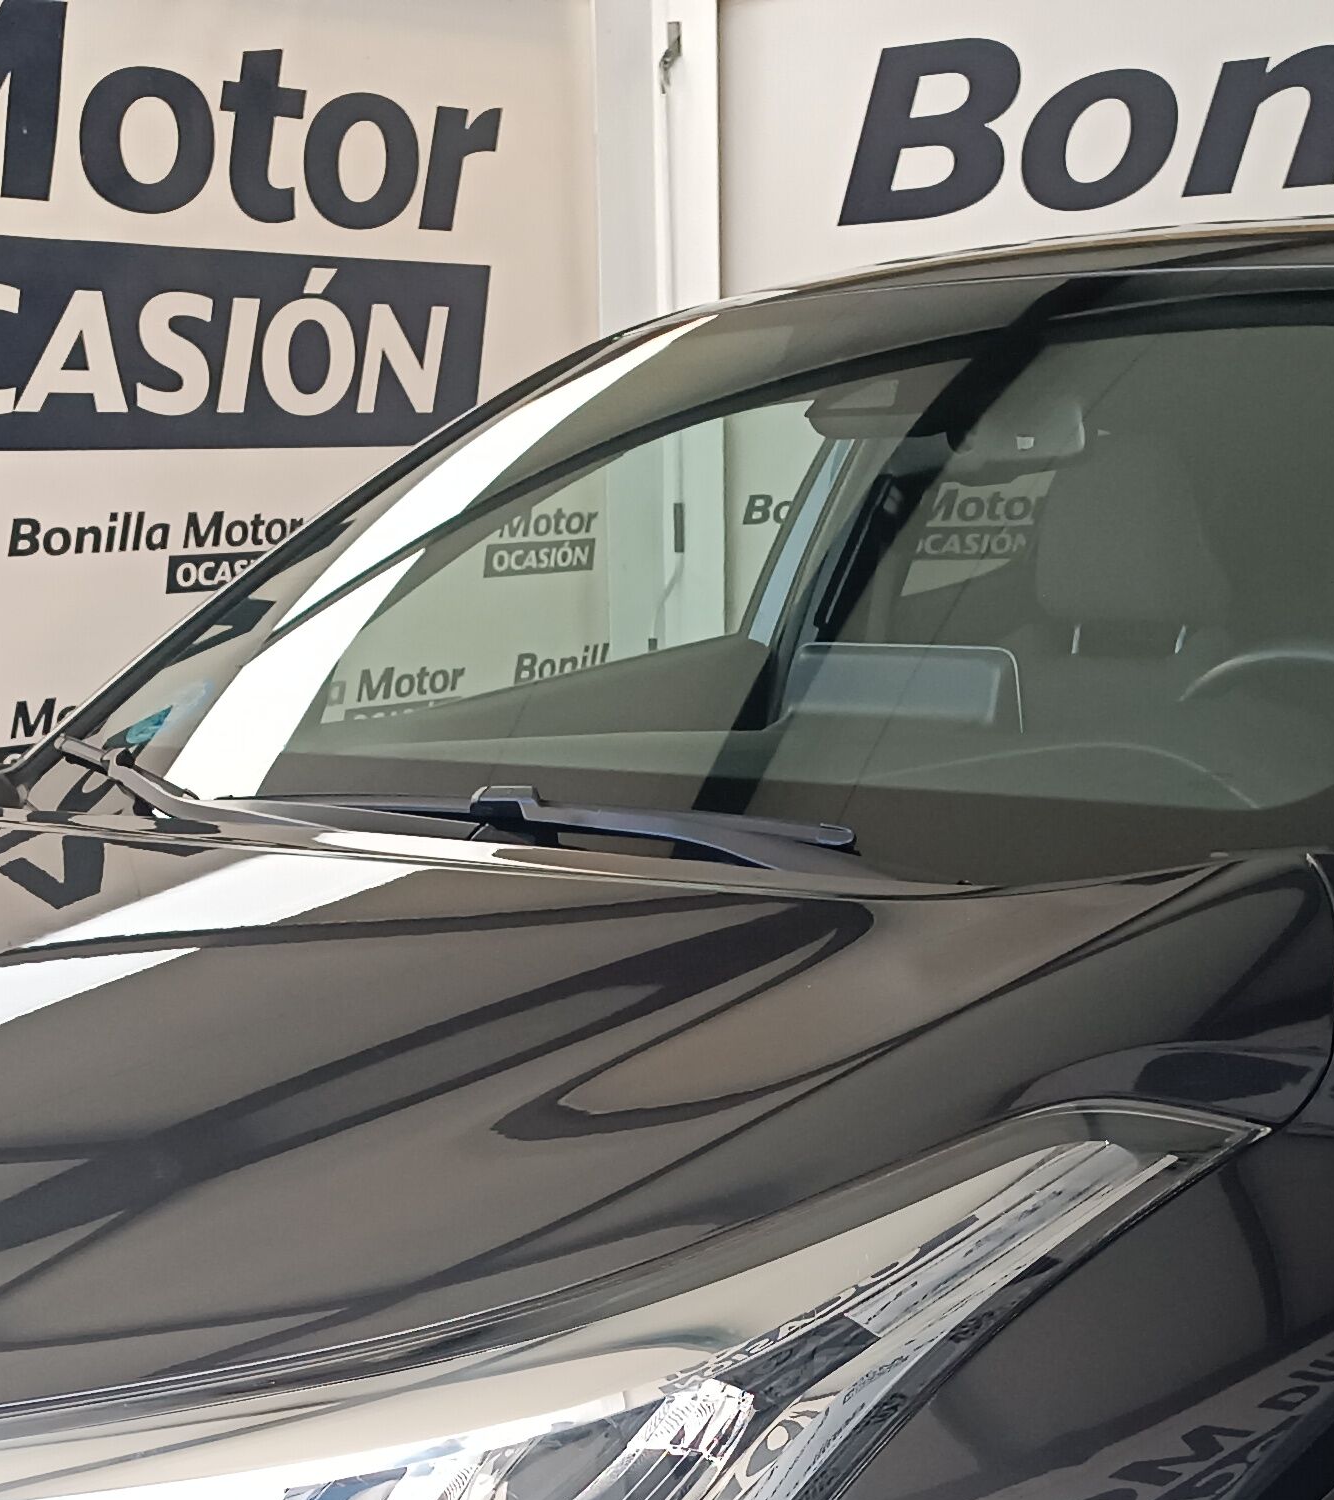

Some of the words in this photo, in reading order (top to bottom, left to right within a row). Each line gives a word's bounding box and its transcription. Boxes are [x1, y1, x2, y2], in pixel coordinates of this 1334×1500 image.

[8, 511, 170, 557] Bonilla
[492, 541, 589, 573] OCASIÓN
[357, 666, 466, 703] Motor
